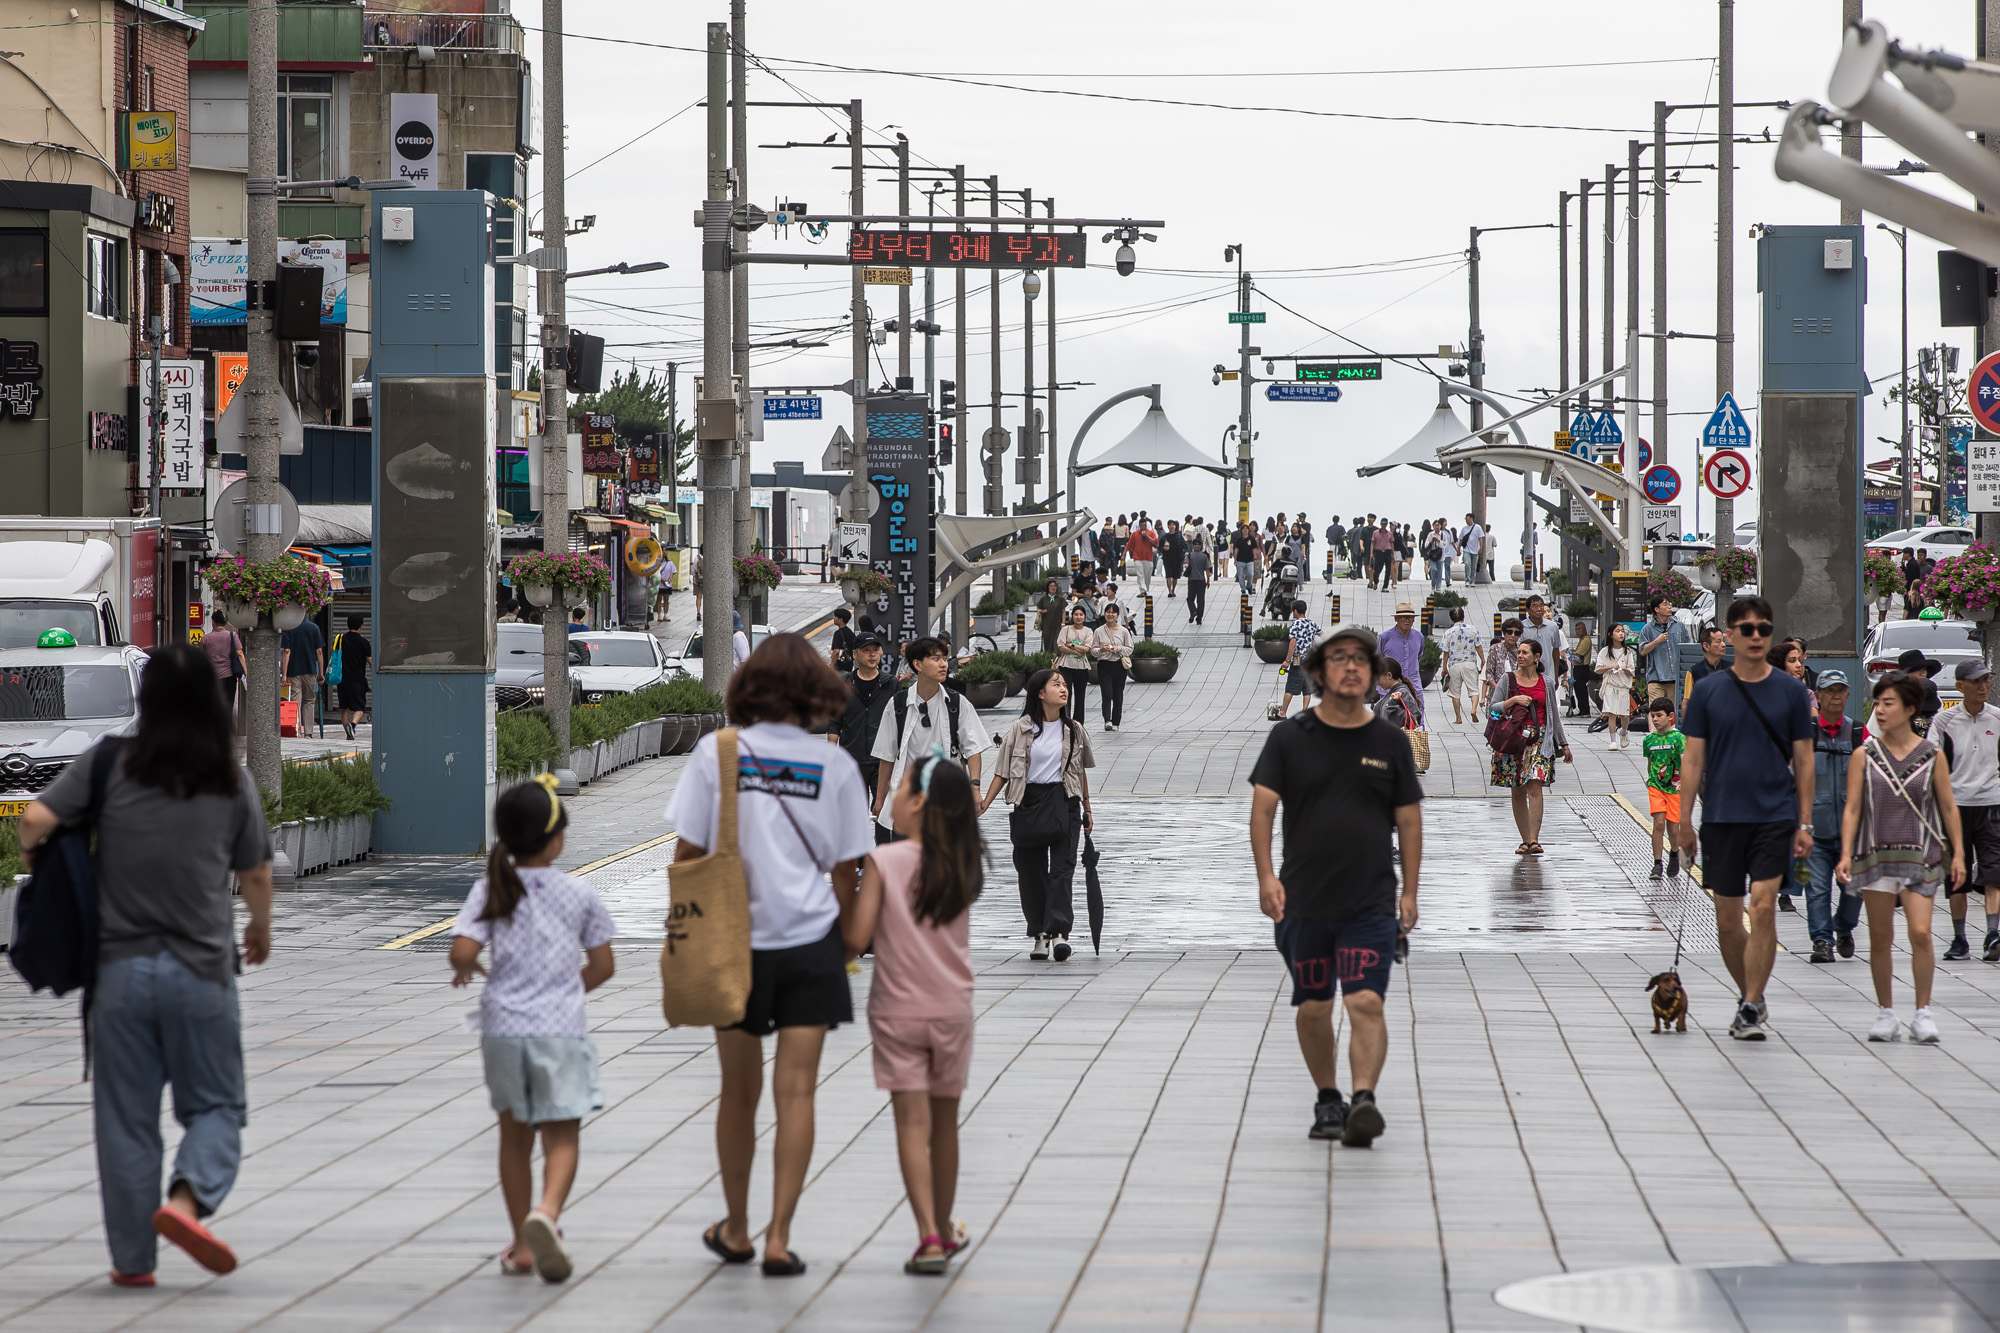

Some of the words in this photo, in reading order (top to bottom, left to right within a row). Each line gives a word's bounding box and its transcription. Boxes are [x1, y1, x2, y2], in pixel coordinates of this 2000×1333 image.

[137, 119, 160, 131] 베이컨
[396, 136, 433, 145] OVERDO
[301, 246, 331, 256] Corona
[949, 234, 990, 262] 3배
[0, 342, 39, 377] 고
[159, 369, 187, 387] 4시
[588, 415, 615, 428] 정통
[171, 392, 194, 482] 돼지국밥
[588, 433, 615, 447] 王家
[1709, 436, 1748, 445] 횡단보도
[583, 452, 621, 470] 탕후루
[630, 478, 661, 493] 탕후루
[1648, 480, 1677, 489] 주정차금지
[871, 474, 918, 553] 해운대
[1646, 510, 1677, 519] 견인지역
[843, 525, 867, 536] 견인지역
